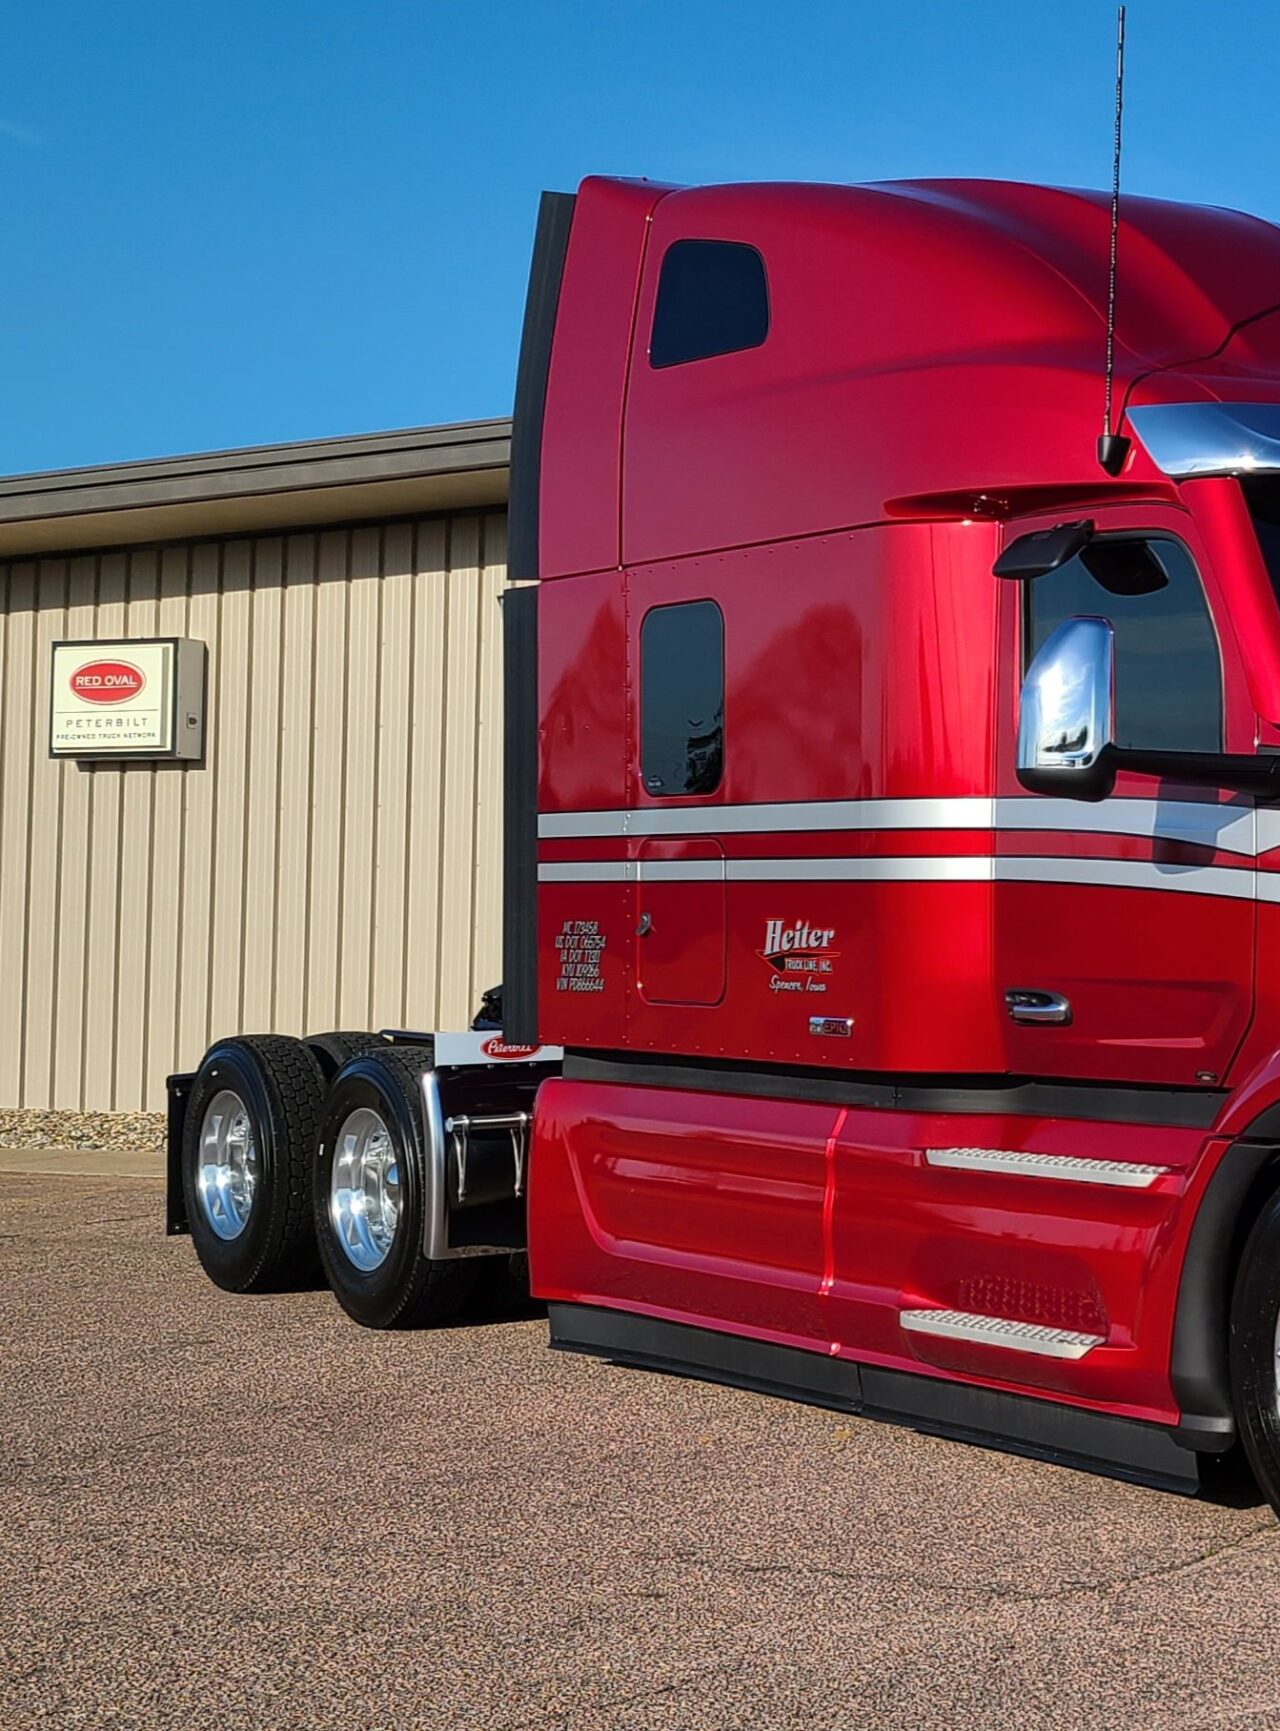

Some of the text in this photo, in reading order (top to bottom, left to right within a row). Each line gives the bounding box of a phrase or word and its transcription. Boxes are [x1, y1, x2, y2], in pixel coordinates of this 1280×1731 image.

[75, 675, 138, 686] RED OVAL
[66, 717, 148, 728] PETERBILT
[763, 919, 835, 956] Heiter
